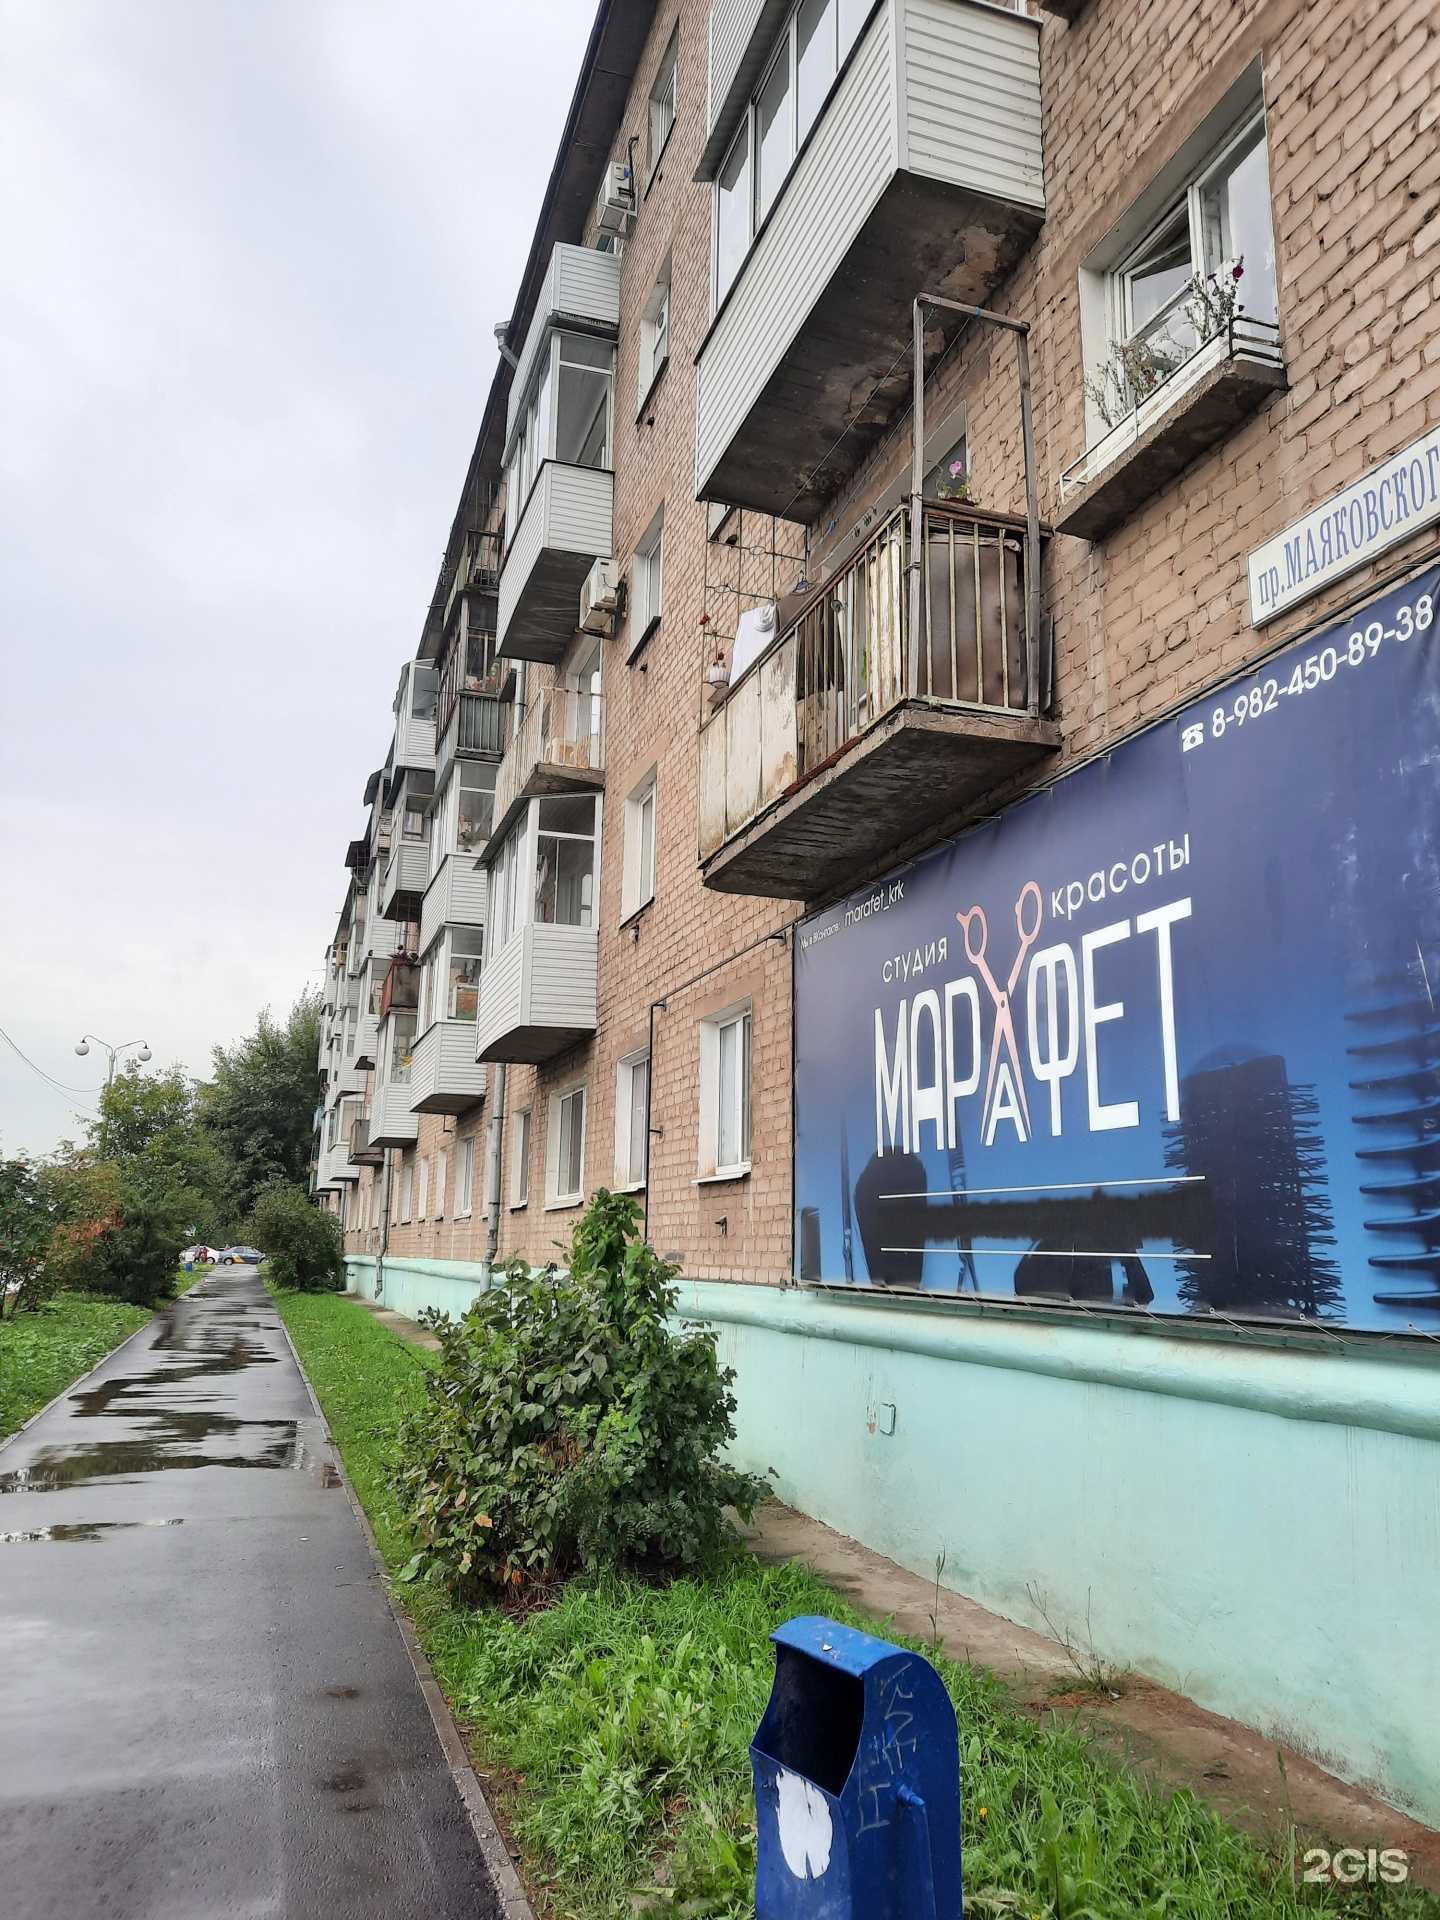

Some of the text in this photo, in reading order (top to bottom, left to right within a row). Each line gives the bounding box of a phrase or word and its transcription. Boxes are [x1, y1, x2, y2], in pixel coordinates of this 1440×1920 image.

[1212, 594, 1434, 738] 8-982-450-89-38
[844, 880, 904, 927] marafet_krk
[882, 833, 1190, 983] студия красоты
[874, 897, 1192, 1158] МАРАФЕТ
